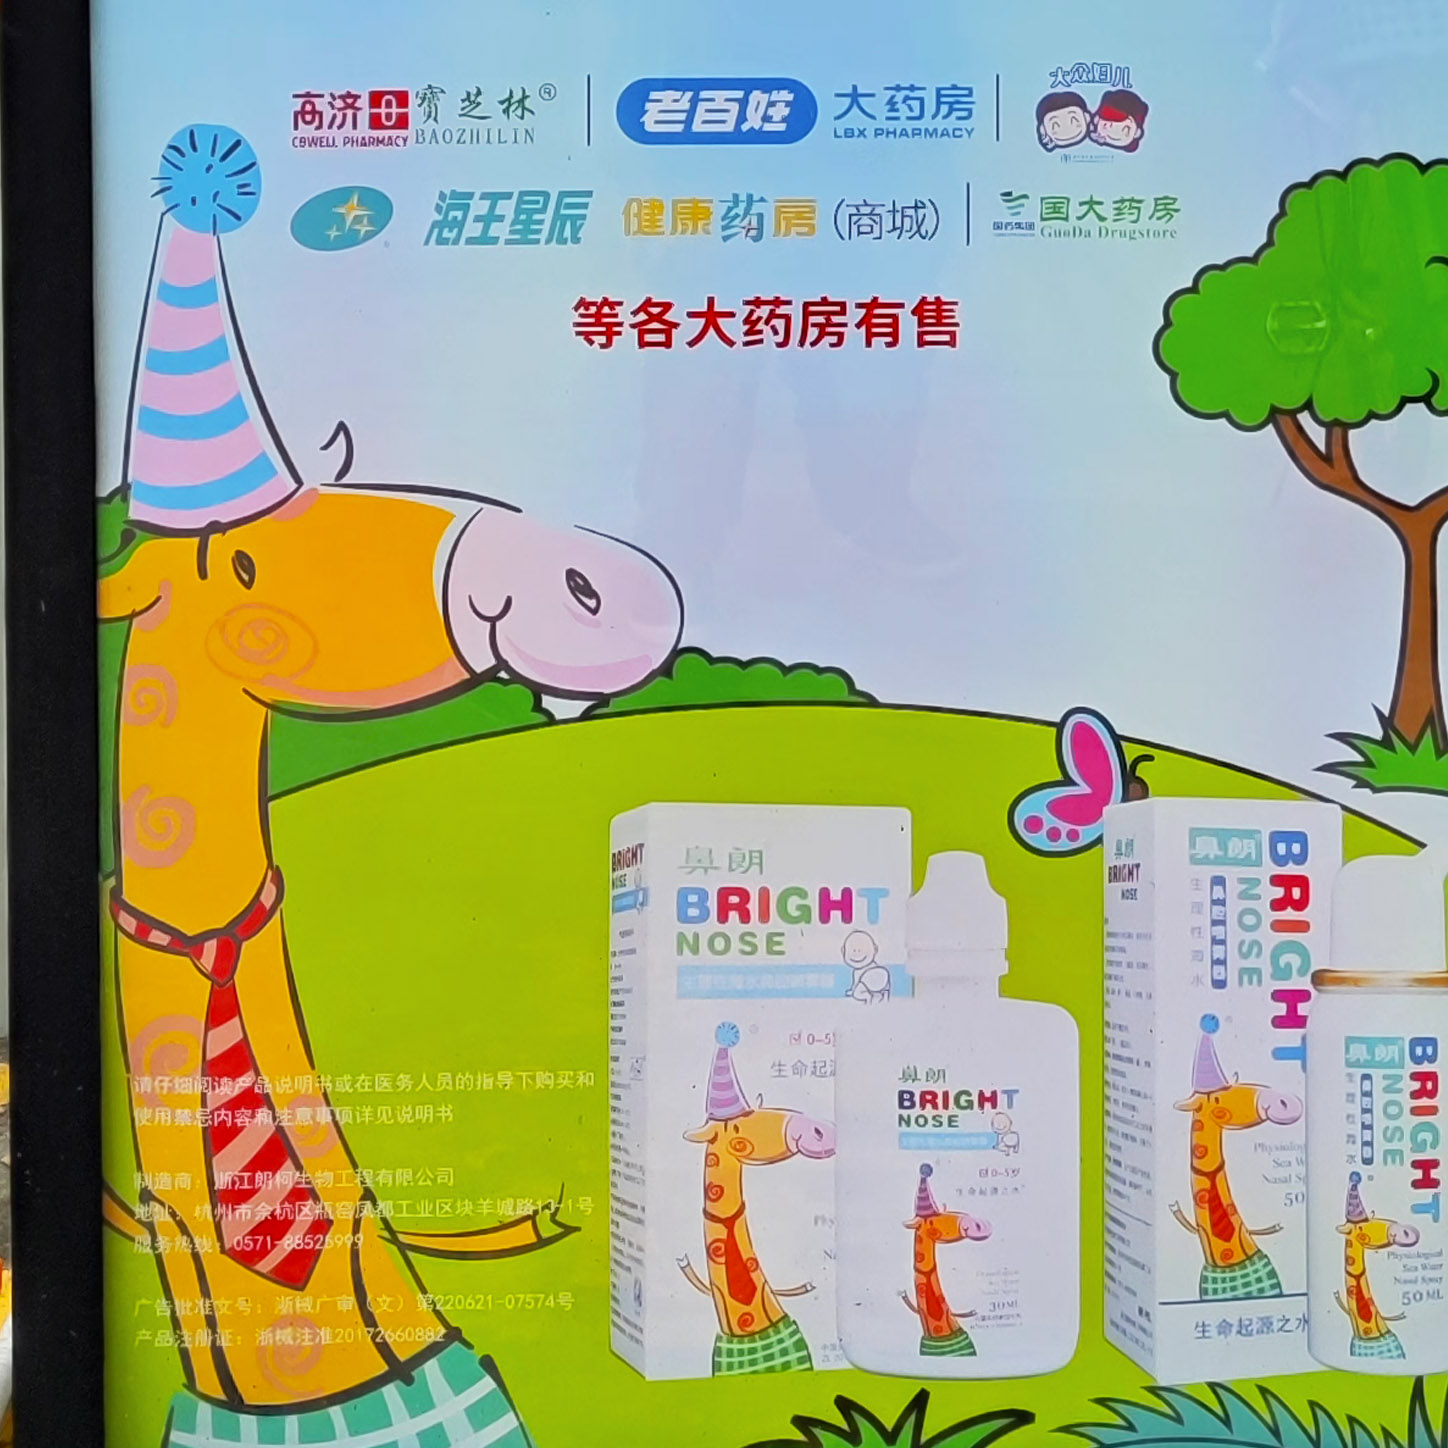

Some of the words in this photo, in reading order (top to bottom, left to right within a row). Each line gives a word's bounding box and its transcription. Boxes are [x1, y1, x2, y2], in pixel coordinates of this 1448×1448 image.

[292, 92, 362, 131] 高济
[640, 88, 796, 133] 老百姓
[833, 84, 976, 122] 大药房
[343, 135, 408, 148] PHARMACY
[415, 127, 535, 145] BAOZHILIN
[833, 126, 870, 139] LBX
[873, 126, 975, 139] PHARMACY
[423, 189, 594, 247] 海王星辰
[622, 194, 818, 243] 健康药房
[1040, 194, 1181, 224] 国大药房
[1098, 225, 1178, 241] Drugstore
[572, 296, 961, 350] 等各大药房有售
[677, 845, 764, 875] 鼻朗
[1108, 862, 1140, 884] BRIGHT
[676, 886, 890, 925] BRIGHT
[1121, 888, 1138, 901] NOSE
[676, 931, 786, 956] NOSE
[1237, 877, 1263, 988] NOSE
[1269, 830, 1312, 1074] BRIGHT
[134, 1070, 595, 1095] 请仔细阅读产品说明书或在医务人员的指导下购买和
[898, 1089, 1019, 1111] BRIGHT
[898, 1114, 959, 1129] NOSE
[1382, 1074, 1404, 1166] NOSE
[1409, 1037, 1441, 1223] BRIGHT
